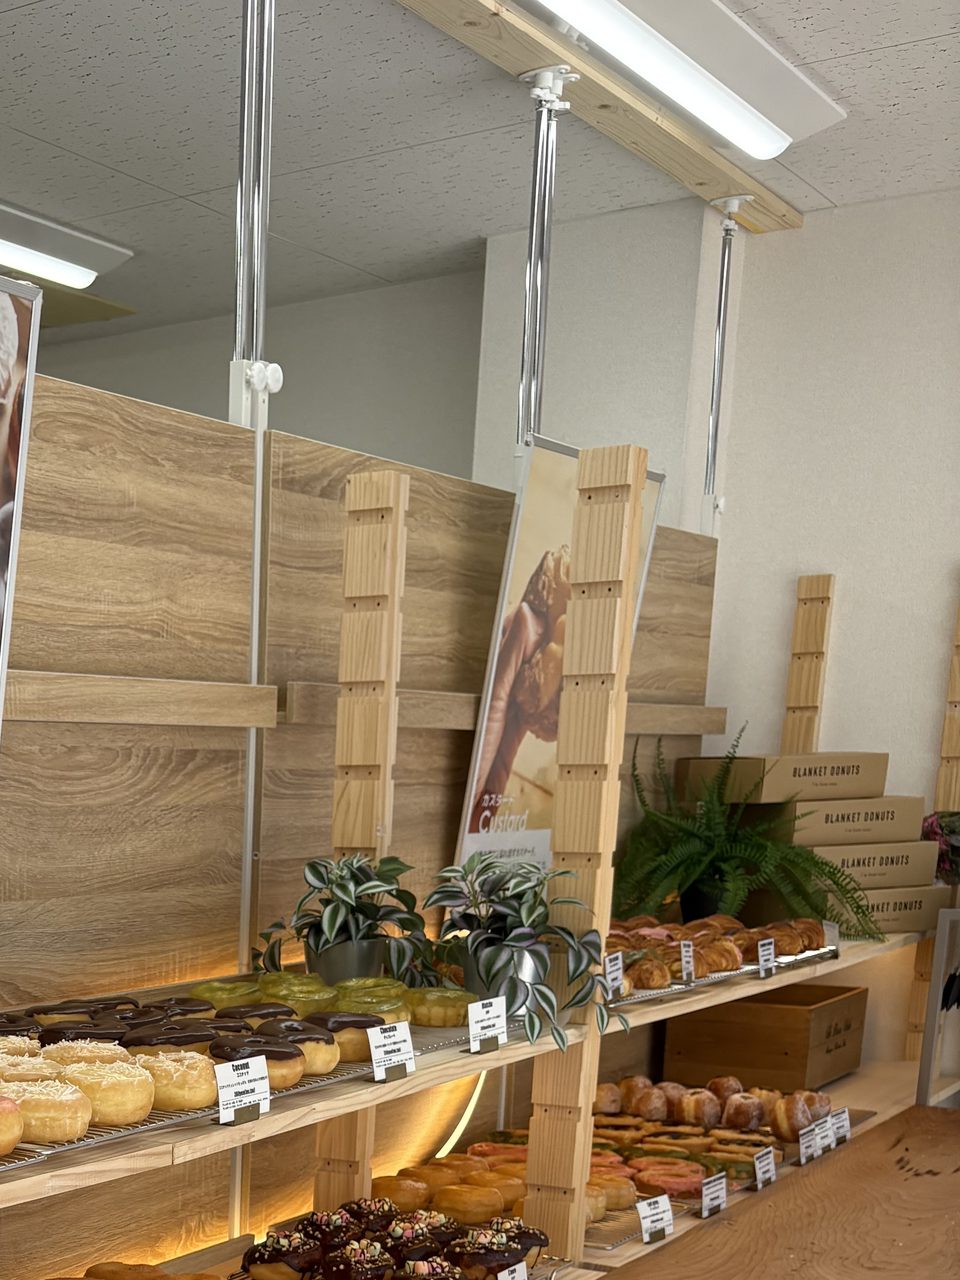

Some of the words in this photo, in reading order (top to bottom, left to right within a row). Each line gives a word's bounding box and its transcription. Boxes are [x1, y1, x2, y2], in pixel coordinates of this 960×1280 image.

[792, 766, 828, 778] BLANKET
[830, 764, 860, 777] DONUTS
[478, 810, 529, 834] Custard
[824, 812, 861, 824] BLANKET
[863, 810, 895, 822] DONUTS
[840, 856, 876, 869] BLANKET
[879, 855, 910, 866] DONUTS
[892, 900, 923, 912] DONUTS
